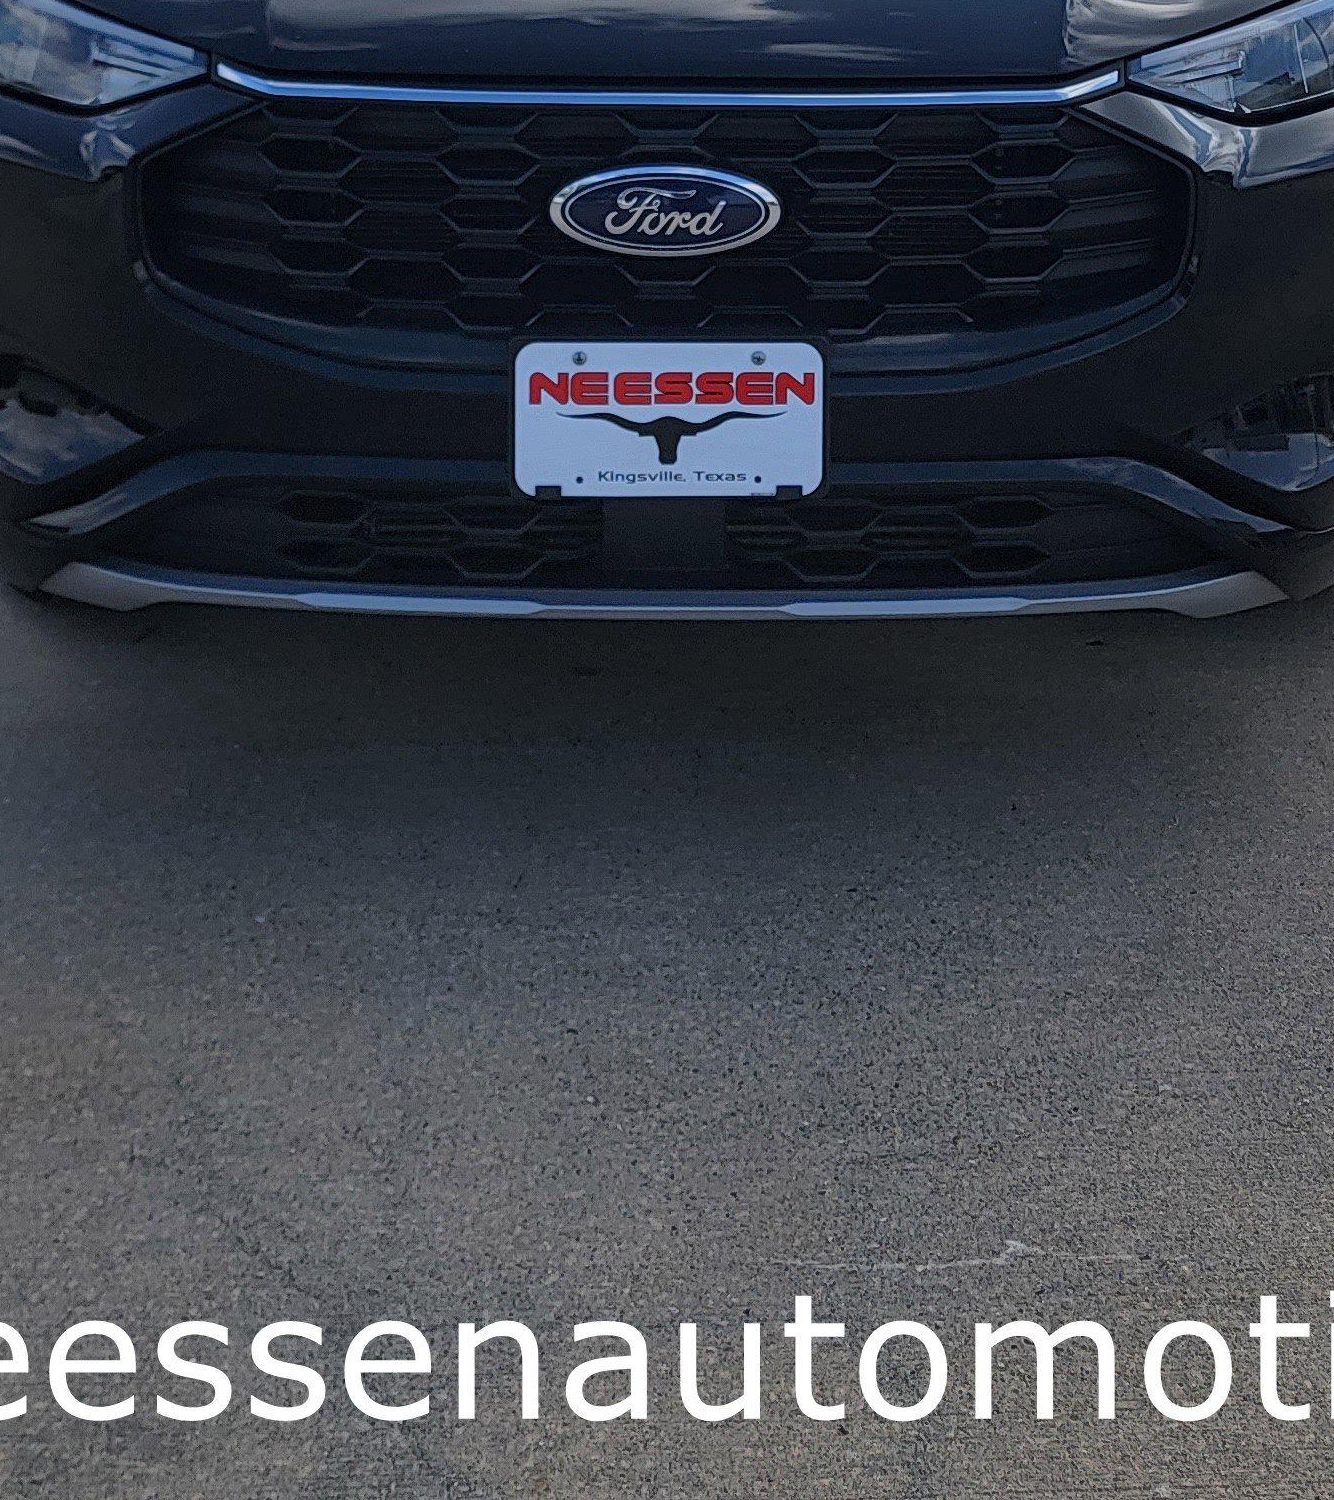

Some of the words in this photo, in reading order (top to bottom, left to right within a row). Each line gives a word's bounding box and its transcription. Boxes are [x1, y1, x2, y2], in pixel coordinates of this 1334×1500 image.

[604, 186, 727, 236] Ford
[529, 371, 816, 405] NEESSEN
[693, 471, 747, 482] Texas
